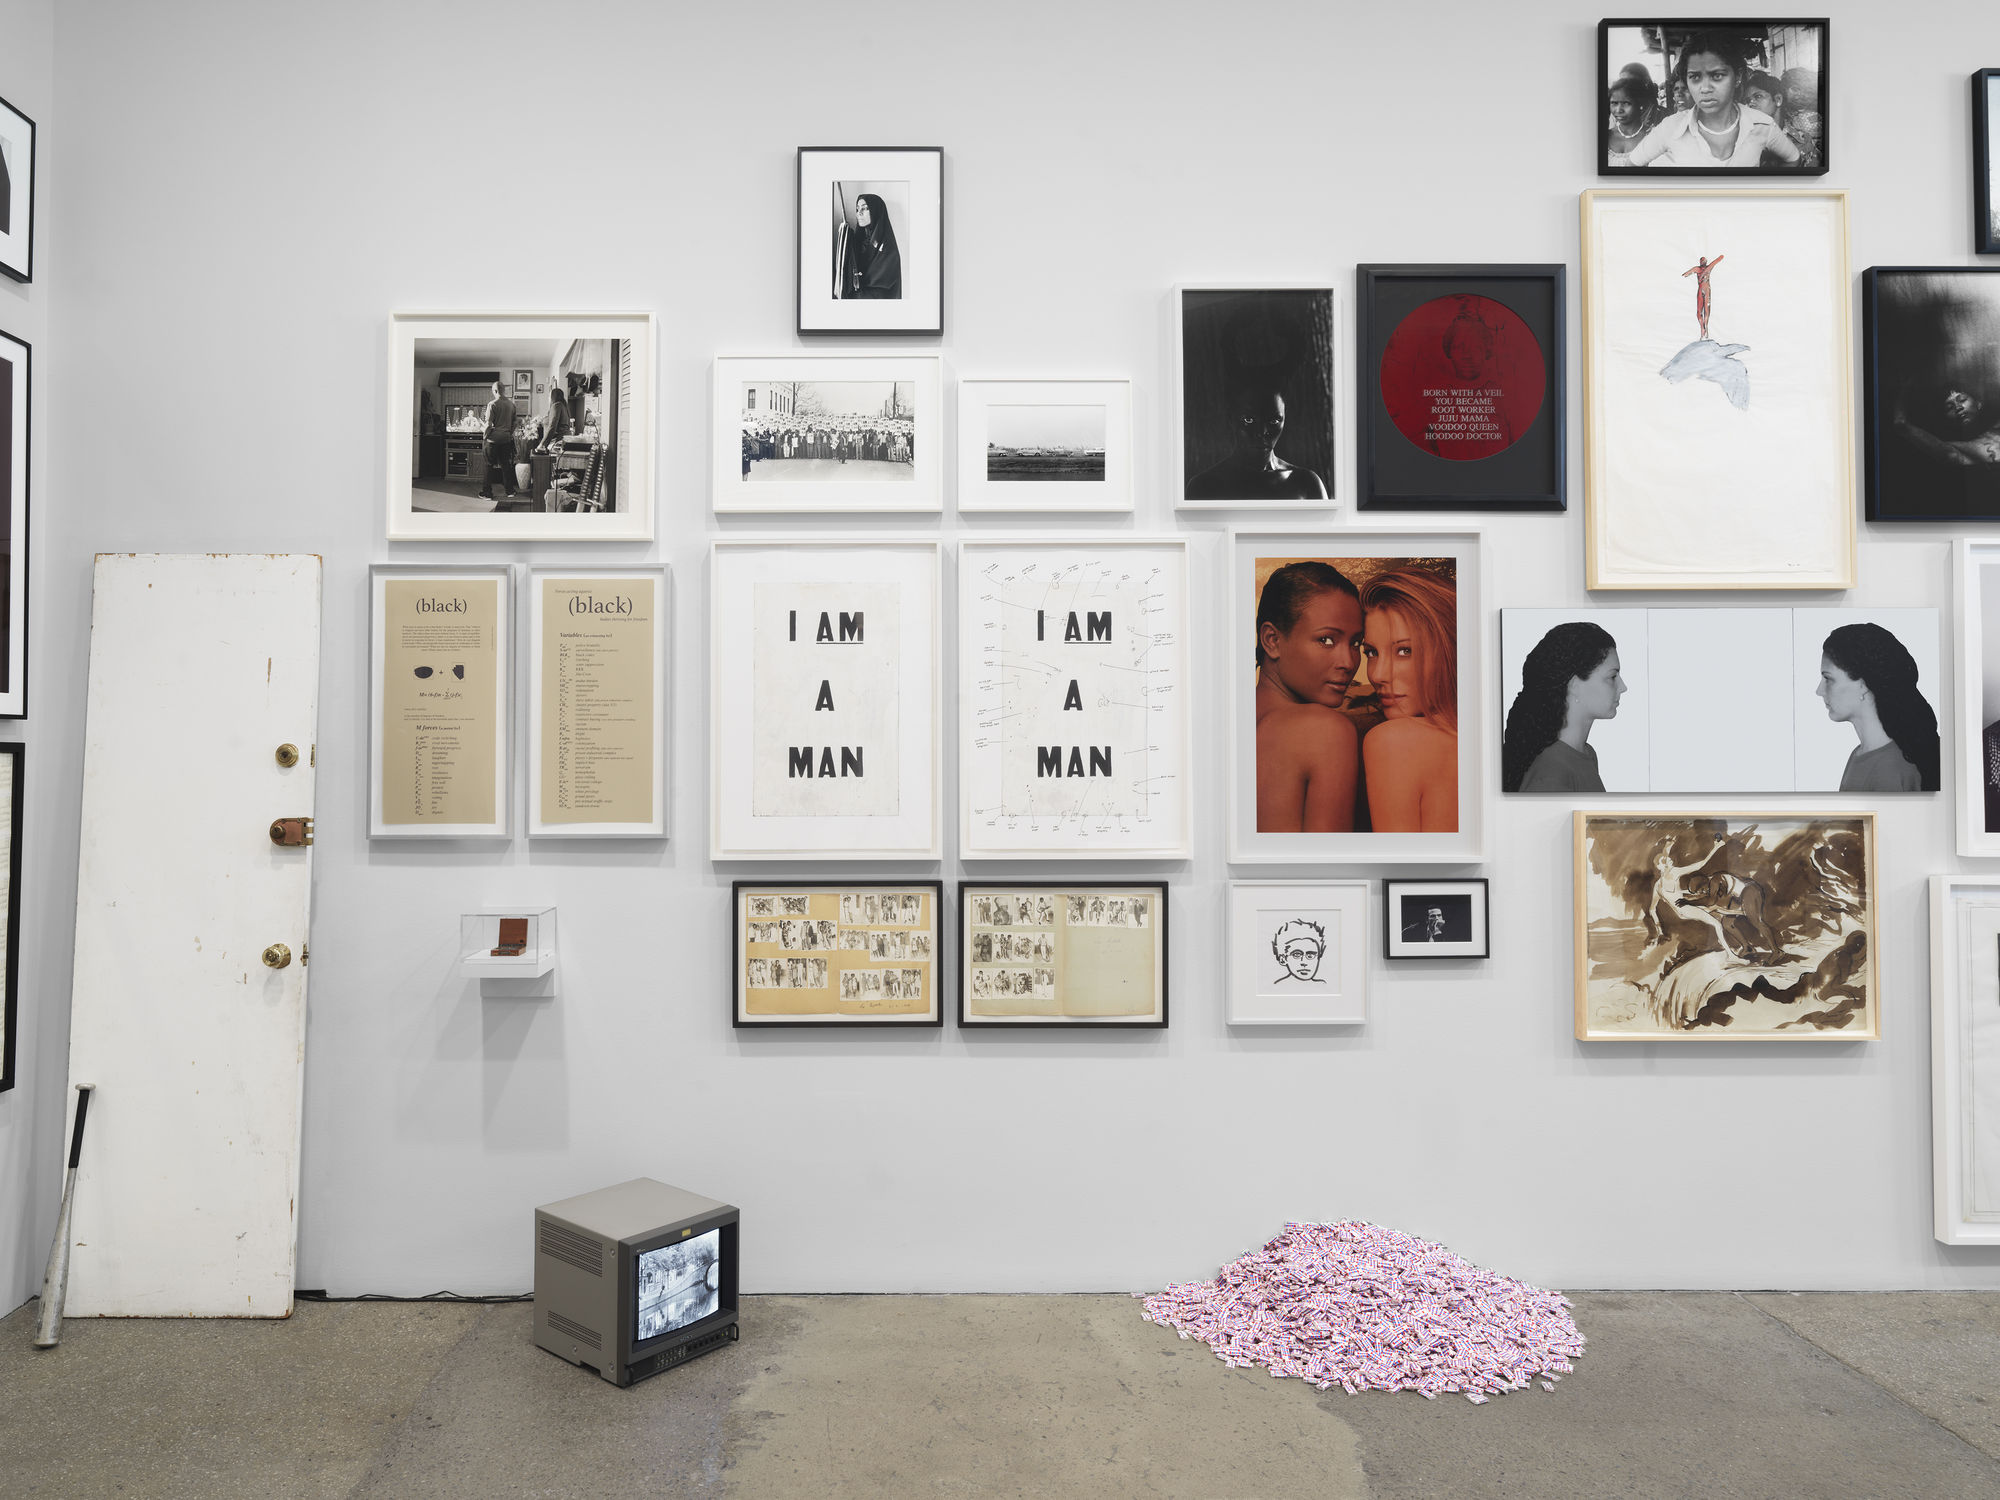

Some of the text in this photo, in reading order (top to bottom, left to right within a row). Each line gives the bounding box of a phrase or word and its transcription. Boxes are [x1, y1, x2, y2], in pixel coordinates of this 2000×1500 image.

[1423, 389, 1504, 397] BORN WITH A VEIL
[1431, 406, 1496, 414] ROOT WORKER
[1425, 432, 1502, 440] HOODOO DOCTOR
[1428, 423, 1499, 431] VOODOO QUEEN
[416, 598, 468, 615] (black)
[568, 596, 633, 616] (black)
[789, 610, 864, 644] I AM
[1037, 609, 1112, 644] I AM
[815, 679, 835, 711] A
[1063, 679, 1083, 711] A
[788, 746, 864, 778] MAN
[1037, 746, 1112, 778] MAN
